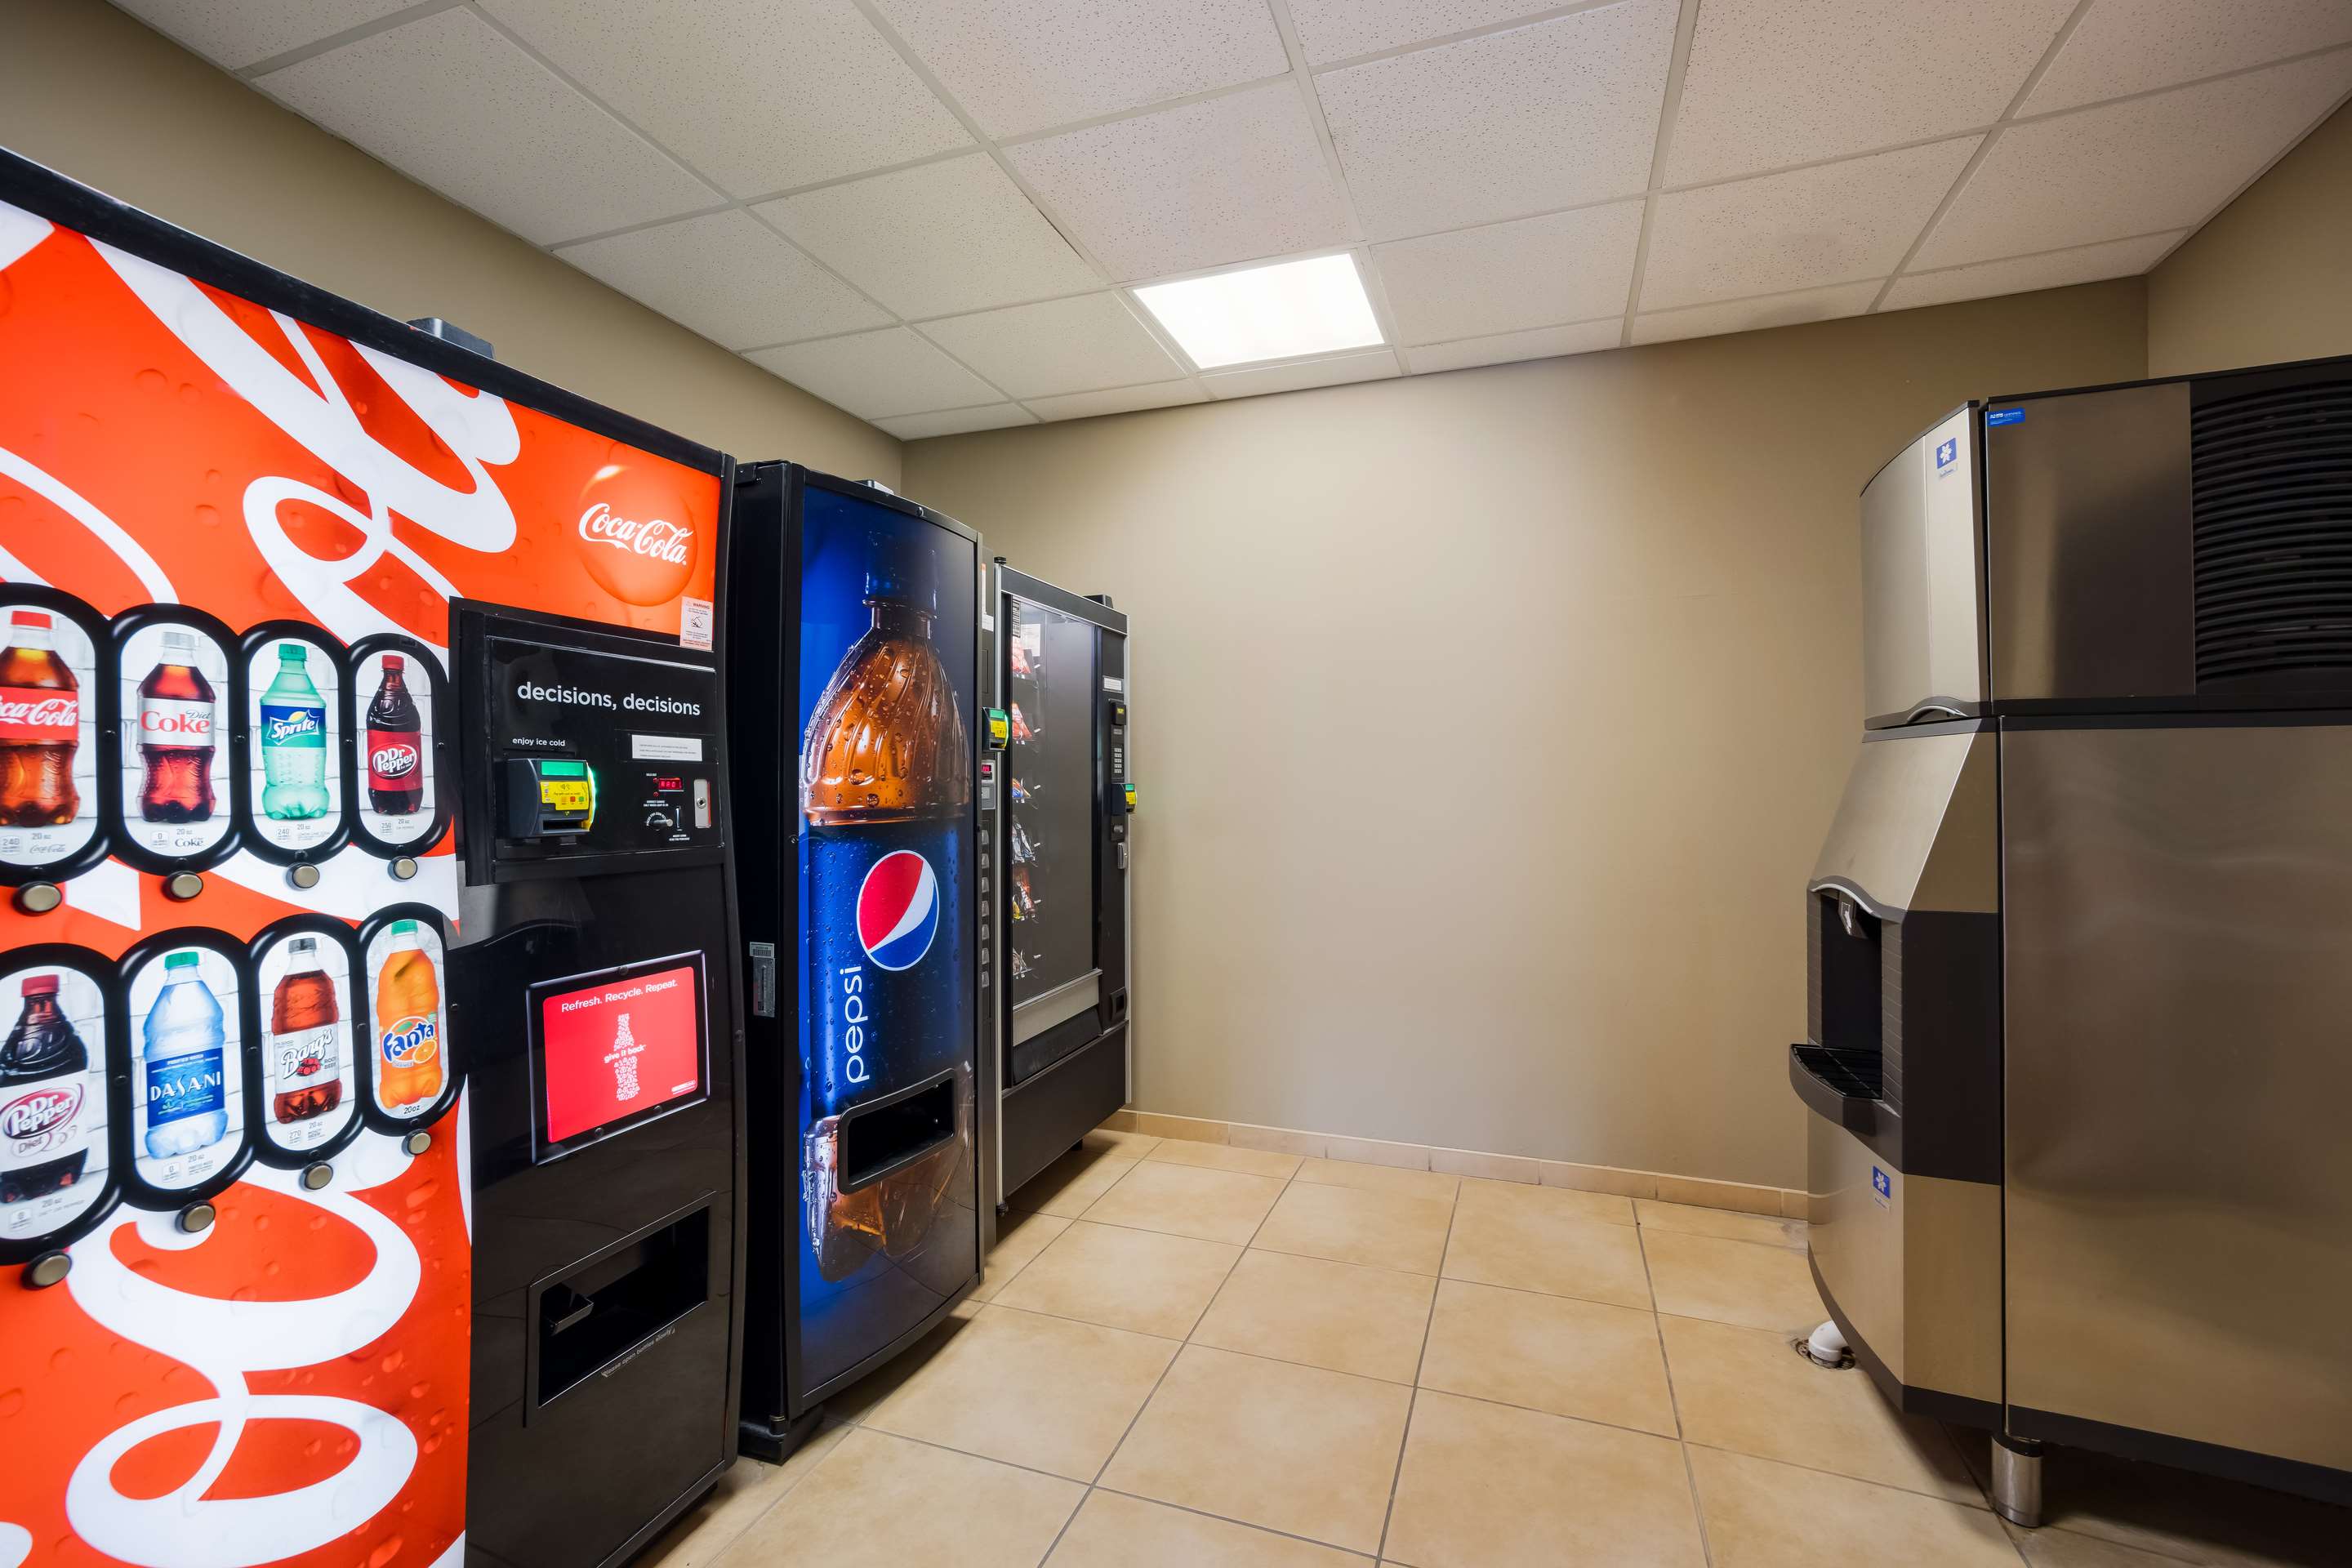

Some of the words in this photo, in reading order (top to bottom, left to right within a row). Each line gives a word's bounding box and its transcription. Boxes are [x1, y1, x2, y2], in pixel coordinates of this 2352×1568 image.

[579, 503, 693, 564] Coca-Cola
[517, 682, 617, 710] decisions,
[623, 693, 701, 715] decisions
[140, 710, 210, 734] Coke
[186, 710, 211, 719] Diet
[271, 717, 315, 739] Sprite
[512, 737, 534, 746] enjoy
[536, 737, 548, 746] ice
[549, 738, 566, 746] cold
[373, 750, 415, 773] Pepper
[388, 748, 405, 761] Dr
[175, 839, 203, 847] Coke
[561, 996, 603, 1013] Refresh.
[605, 987, 644, 1003] Recycle.
[645, 979, 678, 994] Repeat.
[840, 965, 870, 1084] pepsi
[281, 1028, 333, 1079] Barq's
[383, 1022, 434, 1062] Fanta
[604, 1052, 620, 1064] give
[627, 1045, 644, 1056] back
[150, 1071, 220, 1101] DASANI
[8, 1097, 74, 1136] Pepper
[29, 1094, 59, 1118] Dr
[19, 1136, 42, 1153] Diet
